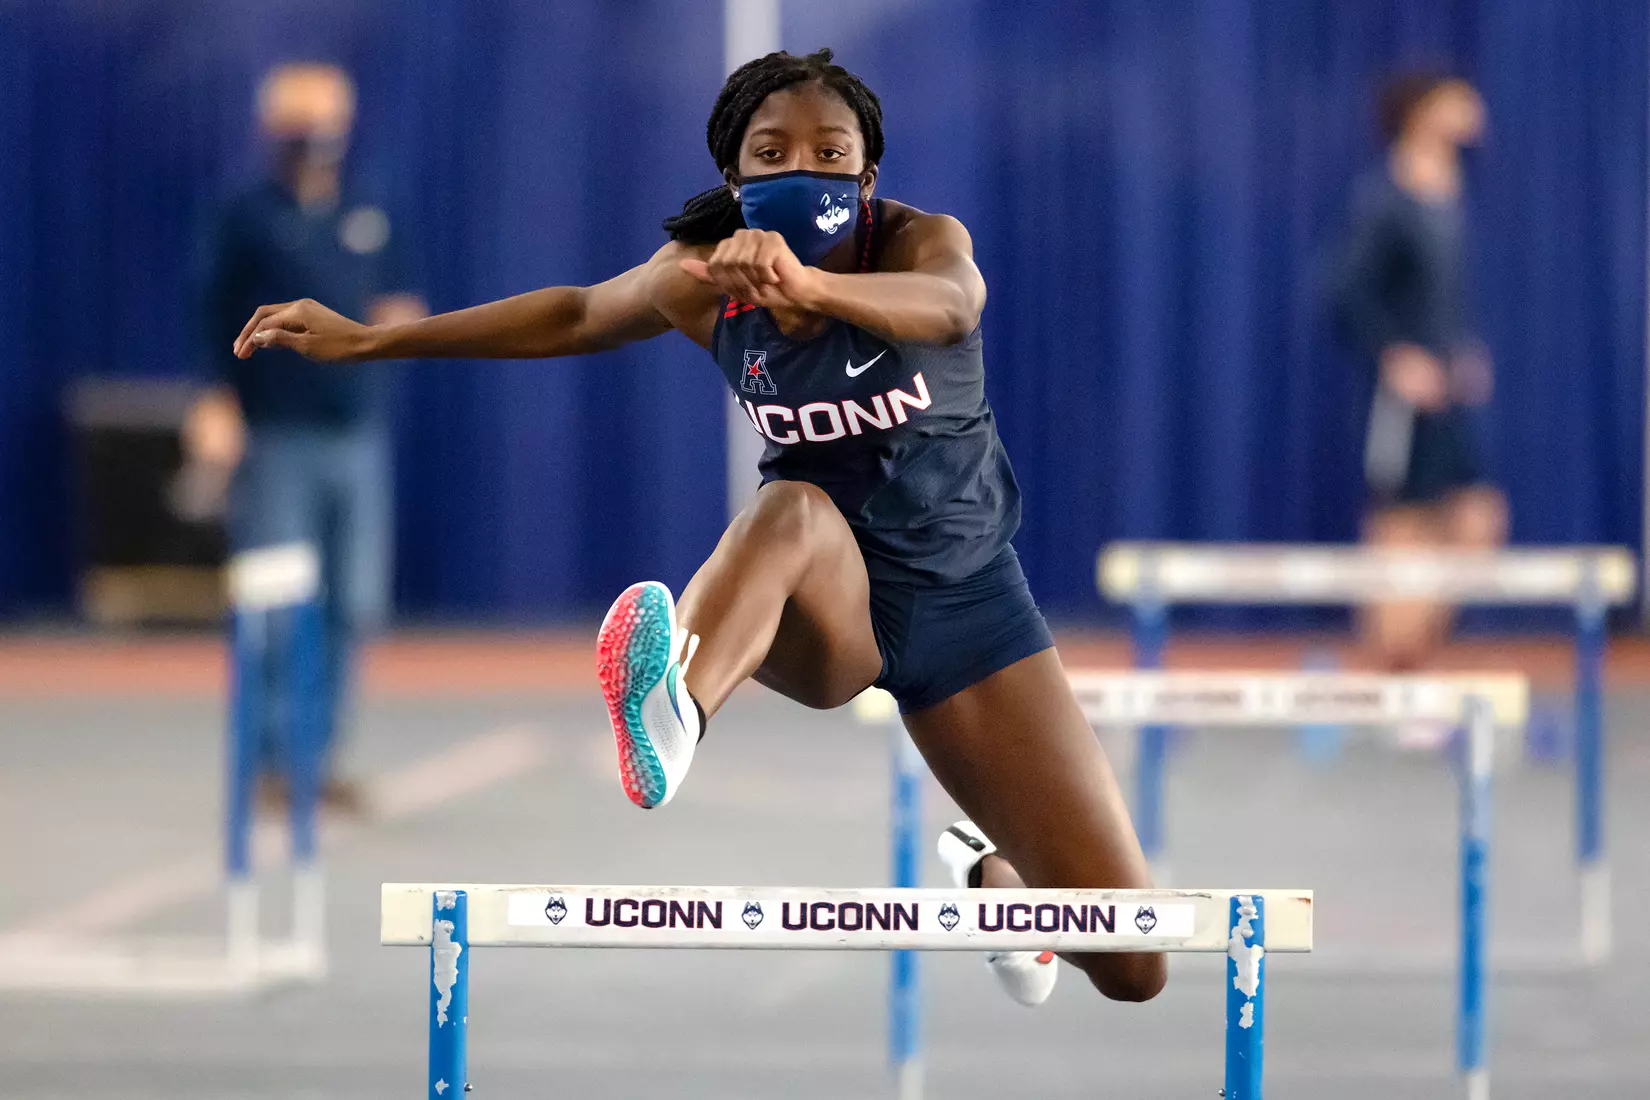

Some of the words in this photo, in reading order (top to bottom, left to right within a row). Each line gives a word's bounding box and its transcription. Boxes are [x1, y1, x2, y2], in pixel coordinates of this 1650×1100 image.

[740, 349, 777, 395] A
[585, 897, 723, 930] UCONN
[782, 901, 919, 932] UCONN
[978, 903, 1116, 934] UCONN
